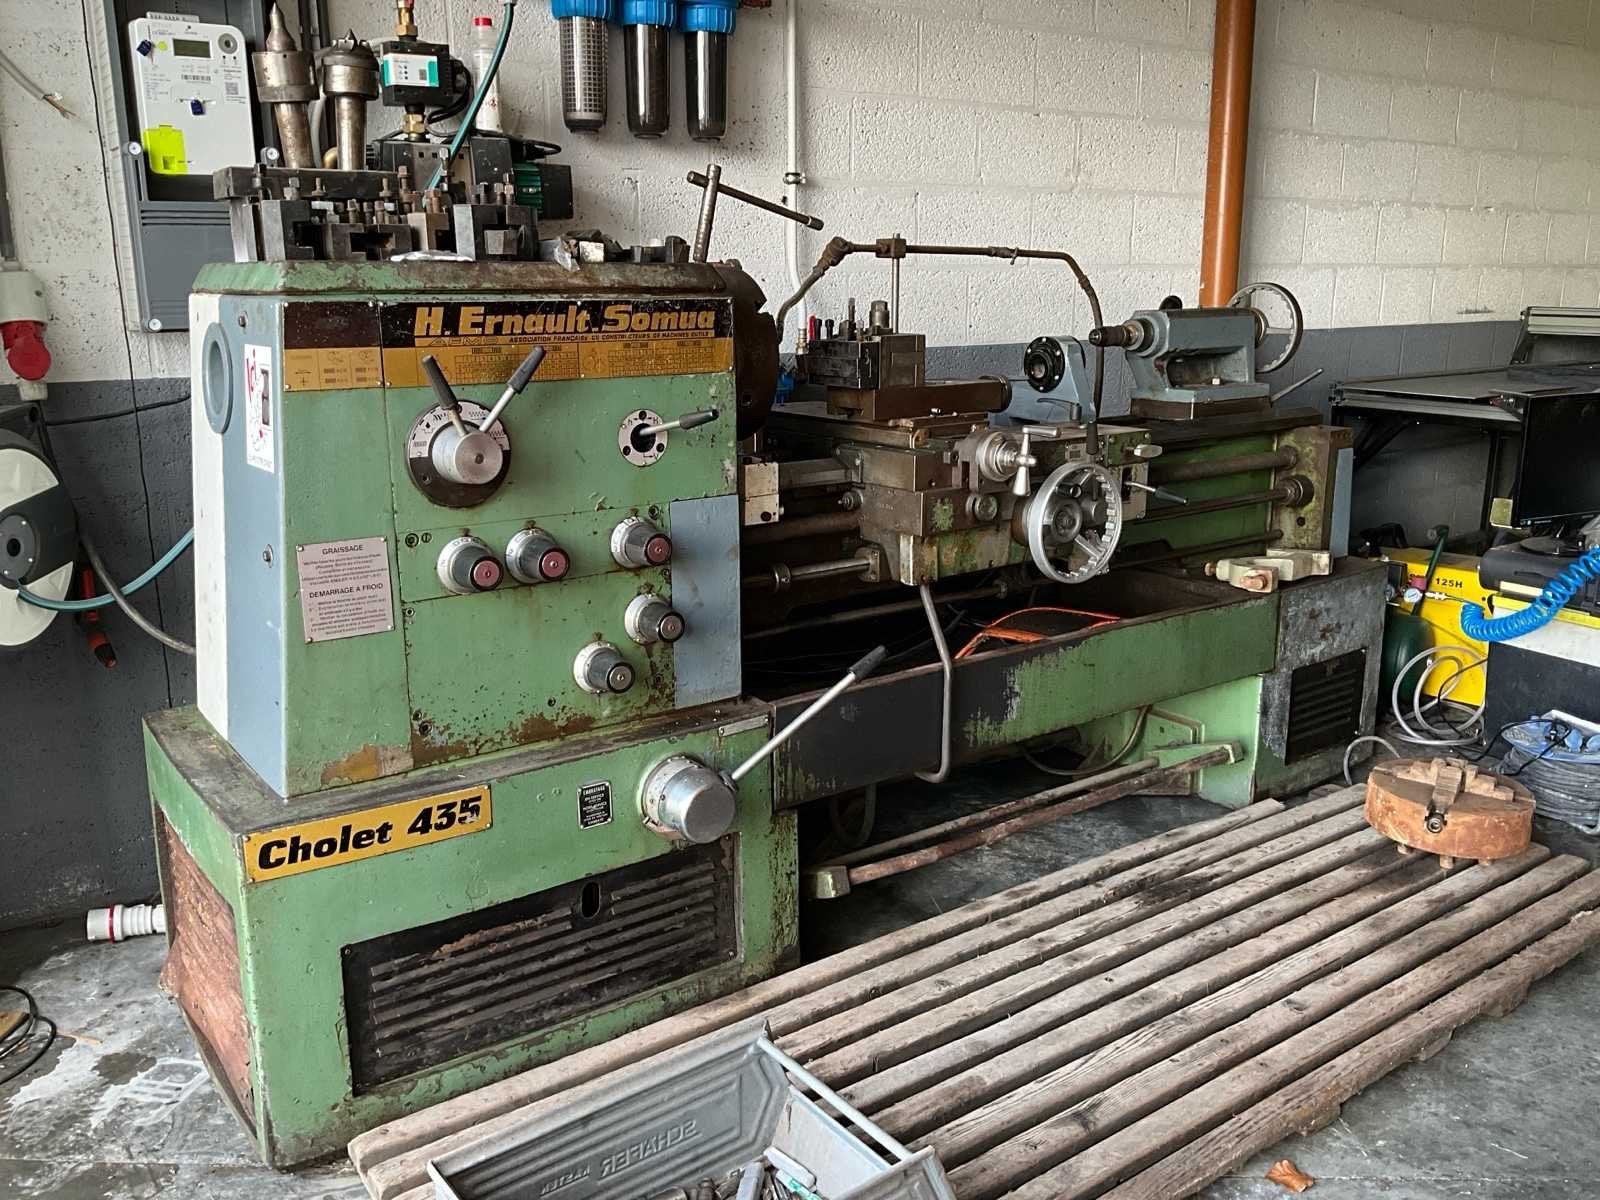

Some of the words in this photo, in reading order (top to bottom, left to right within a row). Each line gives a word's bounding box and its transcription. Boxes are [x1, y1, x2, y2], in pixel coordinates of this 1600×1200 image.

[414, 306, 450, 336] H.
[601, 304, 716, 332] Somua
[322, 544, 364, 555] GRAISSAGE
[309, 586, 355, 599] DEMARRAGE
[362, 582, 384, 591] FROID
[1436, 577, 1463, 588] 125H
[258, 821, 393, 870] Cholet
[407, 796, 482, 836] 435
